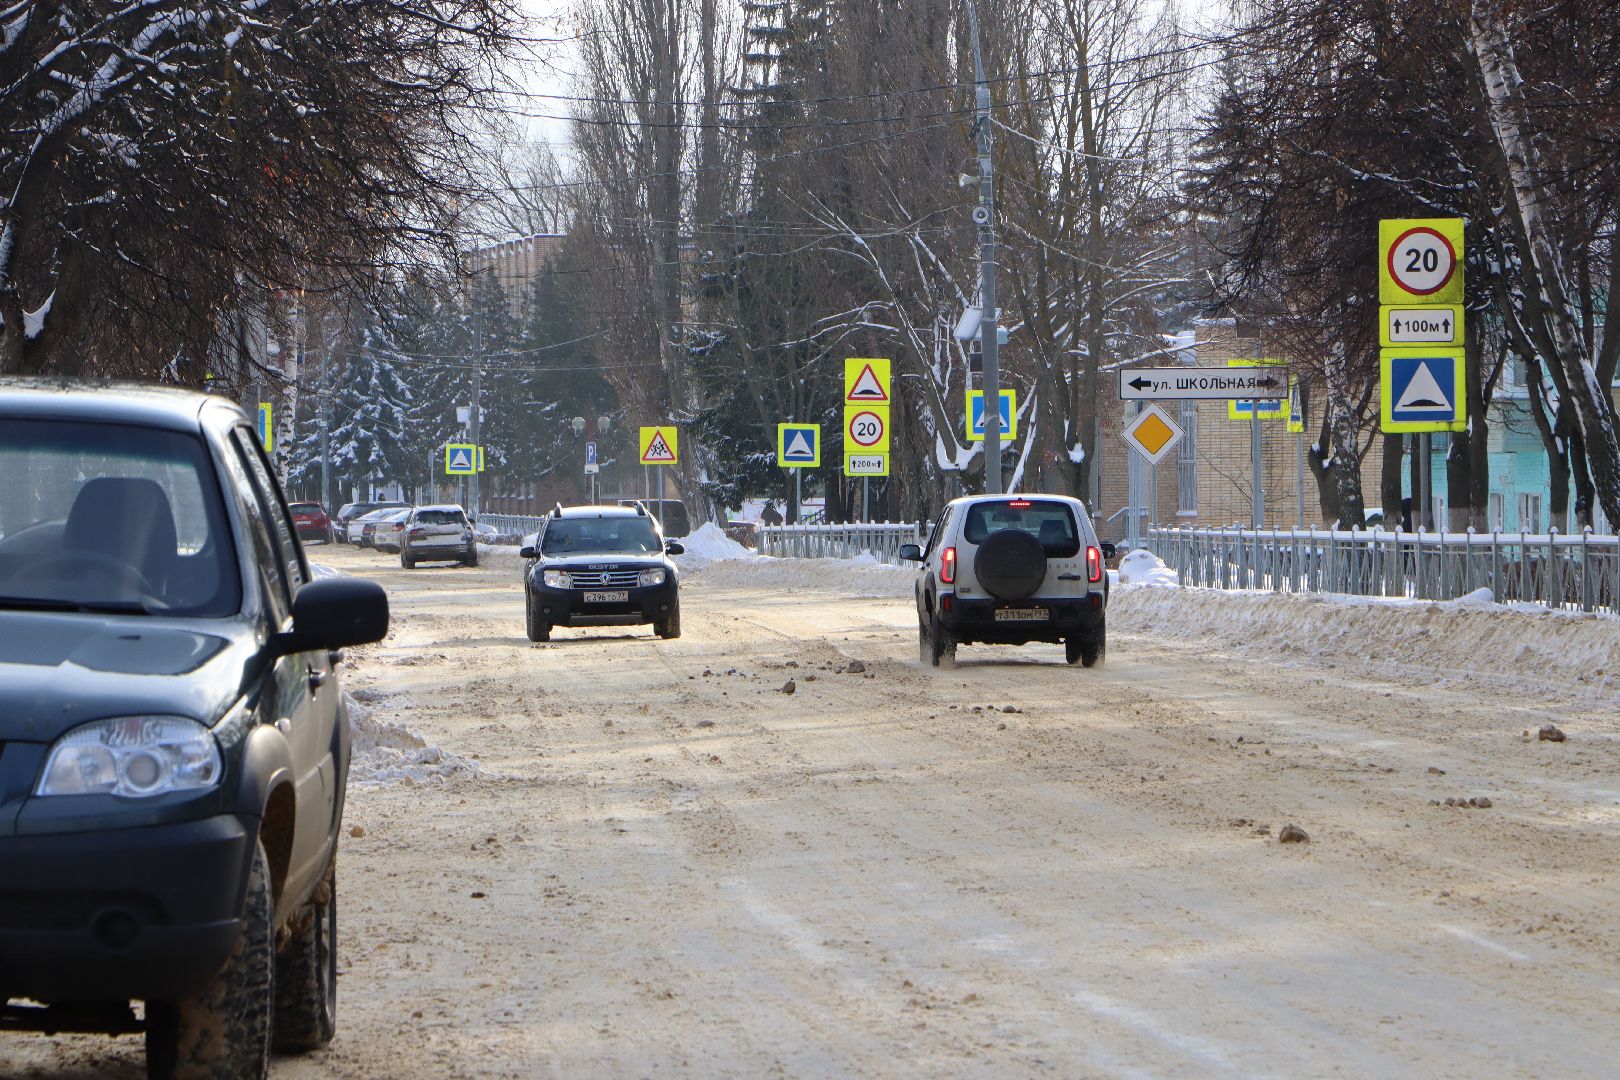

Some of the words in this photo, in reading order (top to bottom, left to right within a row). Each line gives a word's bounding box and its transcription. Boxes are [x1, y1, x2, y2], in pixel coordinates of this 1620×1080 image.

[1405, 248, 1439, 273] 20
[1404, 320, 1440, 333] 100м
[1152, 381, 1172, 392] ул.
[1176, 377, 1256, 390] ШКОЛЬНАЯ
[857, 422, 877, 437] 20
[588, 445, 594, 462] P
